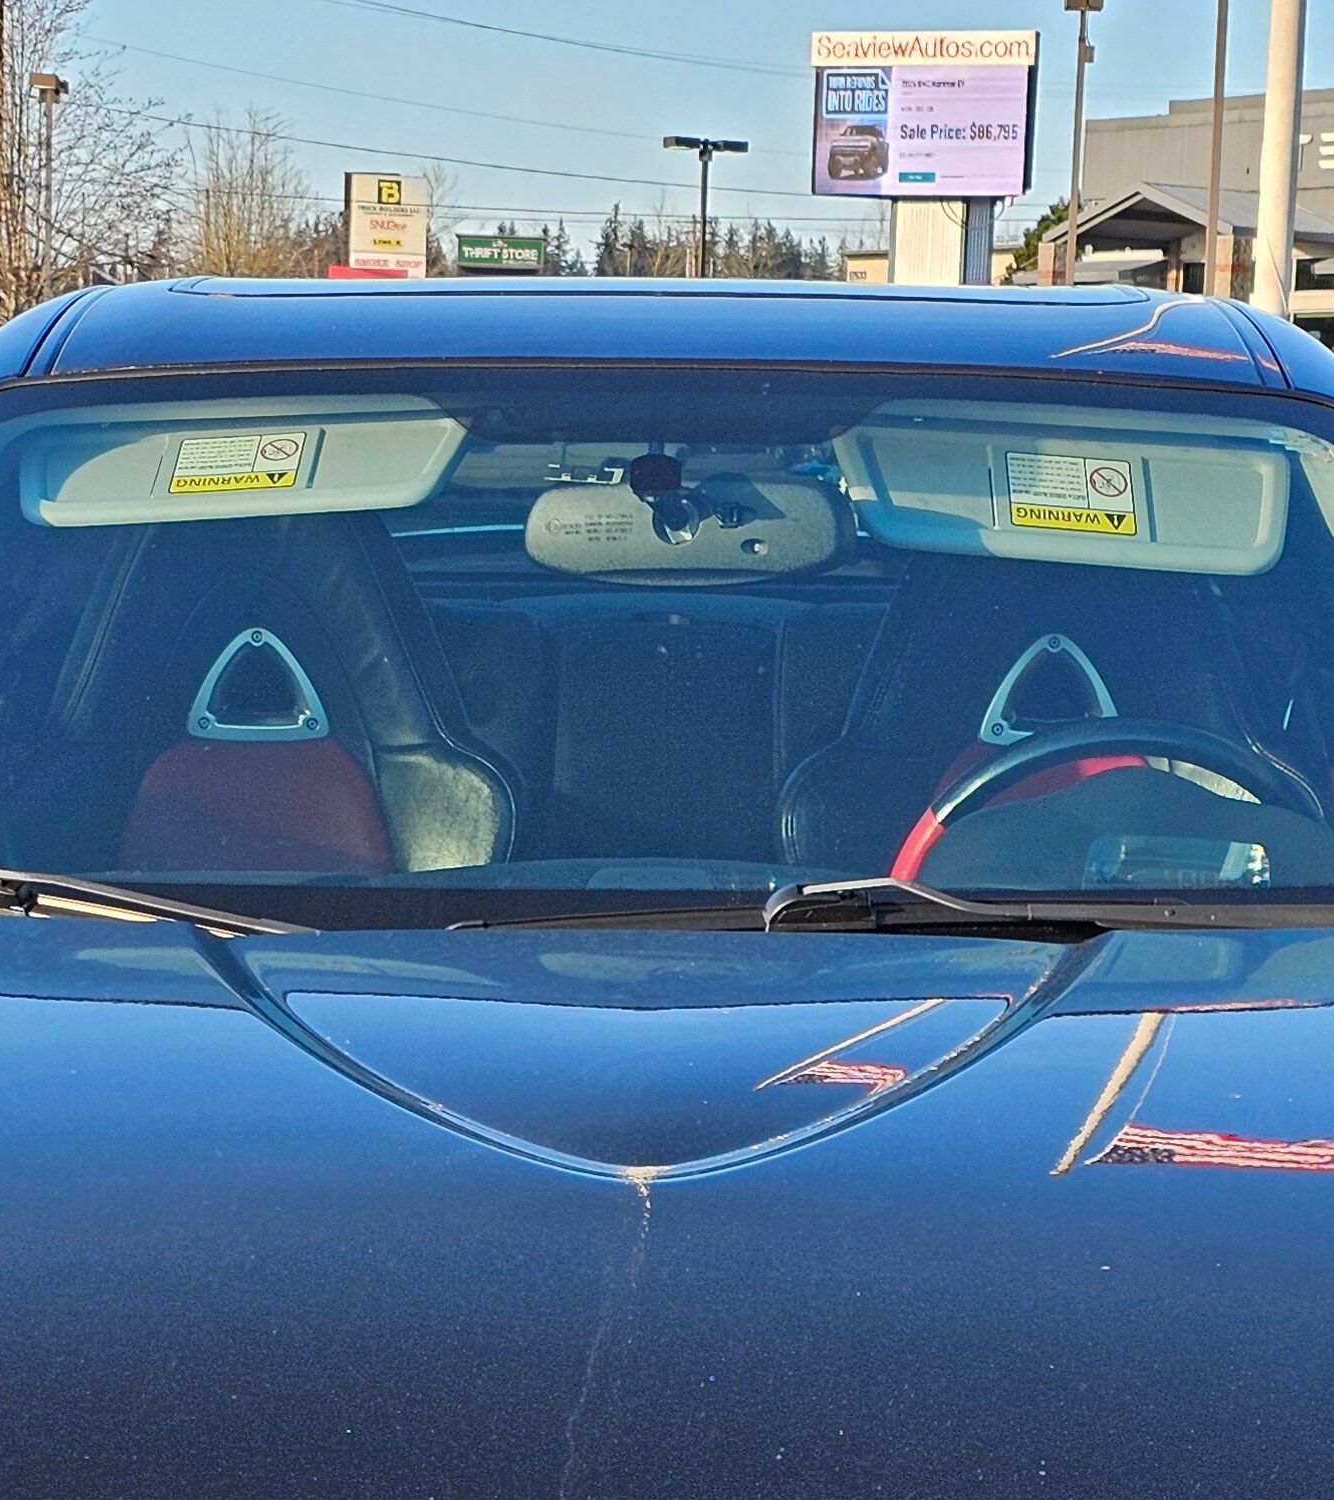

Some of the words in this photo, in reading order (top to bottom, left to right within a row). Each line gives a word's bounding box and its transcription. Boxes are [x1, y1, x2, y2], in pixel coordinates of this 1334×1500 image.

[818, 35, 1030, 60] SeaviewAutos.com
[828, 90, 852, 112] INTO
[854, 90, 886, 112] RIDES
[900, 124, 927, 140] Sale
[931, 124, 966, 140] Price:
[970, 121, 1018, 141] $86,795
[462, 246, 500, 259] THRIFT
[502, 248, 539, 260] STORE
[176, 475, 260, 488] WARNING
[1017, 507, 1101, 524] WARNING
